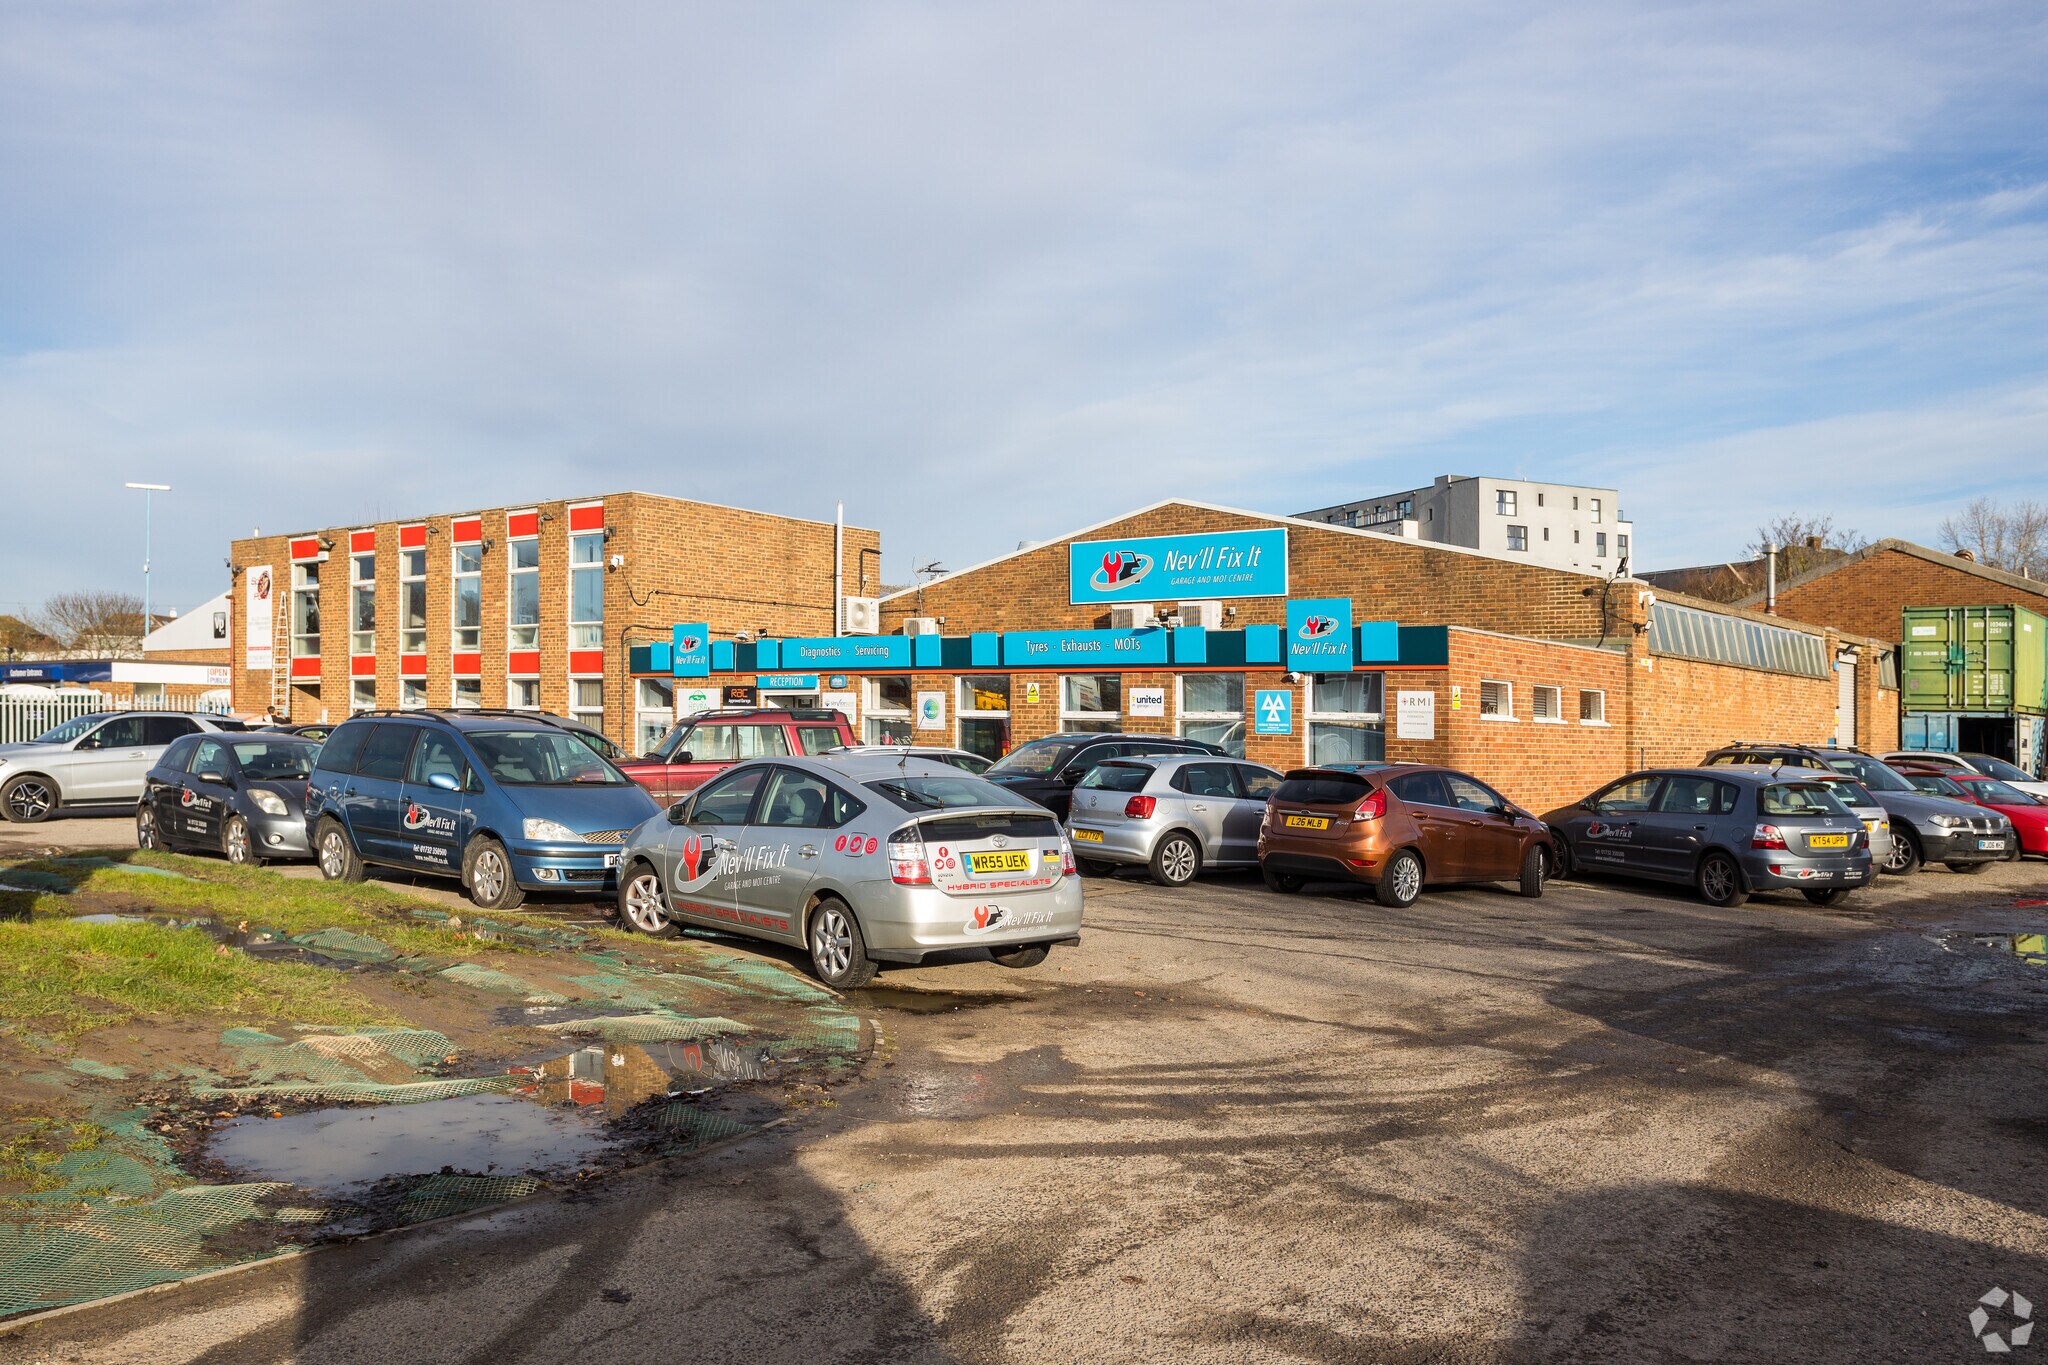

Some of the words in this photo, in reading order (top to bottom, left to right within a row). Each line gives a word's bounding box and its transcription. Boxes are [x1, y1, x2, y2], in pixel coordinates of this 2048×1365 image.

[1163, 546, 1214, 572] Nev'll
[1215, 546, 1244, 569] Fix
[1246, 545, 1262, 568] It
[1170, 576, 1196, 586] GARAGE
[1197, 576, 1211, 585] AND
[1212, 574, 1227, 584] MOT
[1227, 573, 1254, 583] CENTRE
[800, 645, 842, 659] Diagnostics
[854, 644, 889, 659] Servicing
[1025, 640, 1049, 656] Tyres
[1061, 638, 1101, 652] Exhausts
[1114, 637, 1141, 650] MOTs
[1291, 642, 1321, 655] Nev'll
[1321, 642, 1338, 655] Fix
[1338, 642, 1348, 655] It
[675, 655, 691, 665] Nev'll
[691, 655, 700, 665] Fix
[701, 655, 706, 665] It
[209, 668, 228, 677] OPEN
[769, 676, 804, 686] RECEPTION
[1136, 694, 1162, 704] united
[1409, 697, 1431, 706] RMI
[441, 818, 450, 830] Fix
[450, 819, 456, 831] It
[1291, 816, 1306, 826] L26
[1306, 818, 1323, 828] MLB
[1812, 837, 1831, 845] KT54
[1831, 836, 1845, 844] UPP
[719, 845, 756, 876] Nev'll
[755, 844, 777, 871] Fix
[777, 843, 790, 868] It
[972, 855, 1004, 870] WR55
[1005, 854, 1028, 868] UEK
[724, 880, 741, 891] GARAGE
[741, 879, 752, 888] AND
[752, 878, 763, 887] MOT
[762, 875, 781, 886] CENTRE
[947, 882, 987, 891] HYBRID
[989, 878, 1052, 888] SPECIALISTS
[675, 900, 713, 916] HYBRID
[714, 907, 789, 930] SPECIALISTS
[1003, 911, 1032, 926] Nev'll
[1031, 911, 1045, 924] Fix
[1045, 910, 1054, 922] It
